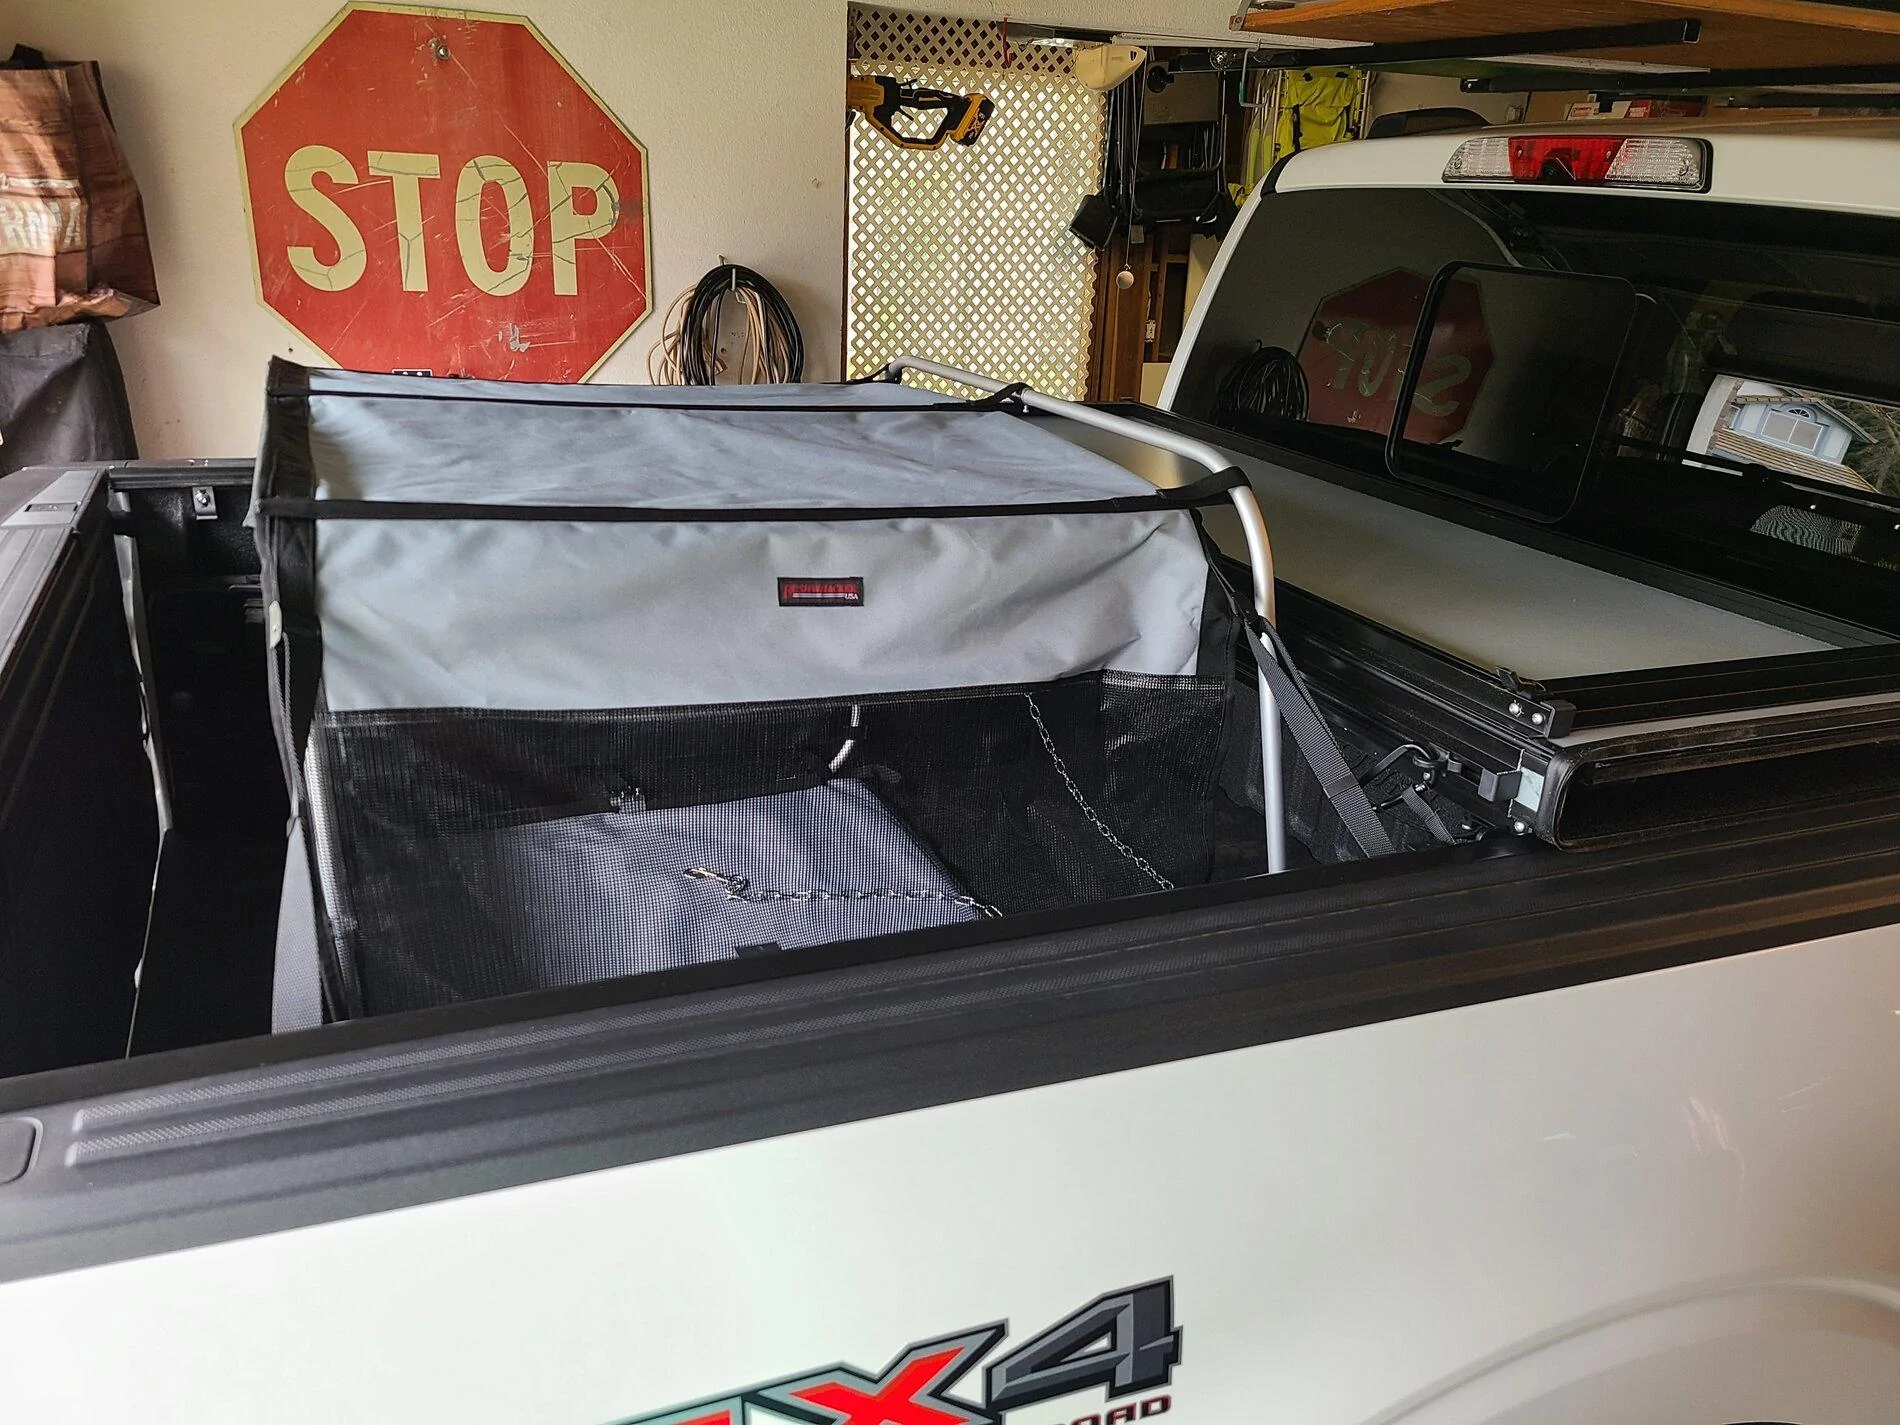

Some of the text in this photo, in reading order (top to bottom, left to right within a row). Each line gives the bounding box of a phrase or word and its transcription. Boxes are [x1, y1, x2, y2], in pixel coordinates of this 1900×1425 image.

[285, 145, 620, 296] STOP
[598, 1275, 1183, 1425] X4
[1054, 1394, 1172, 1425] OAD
